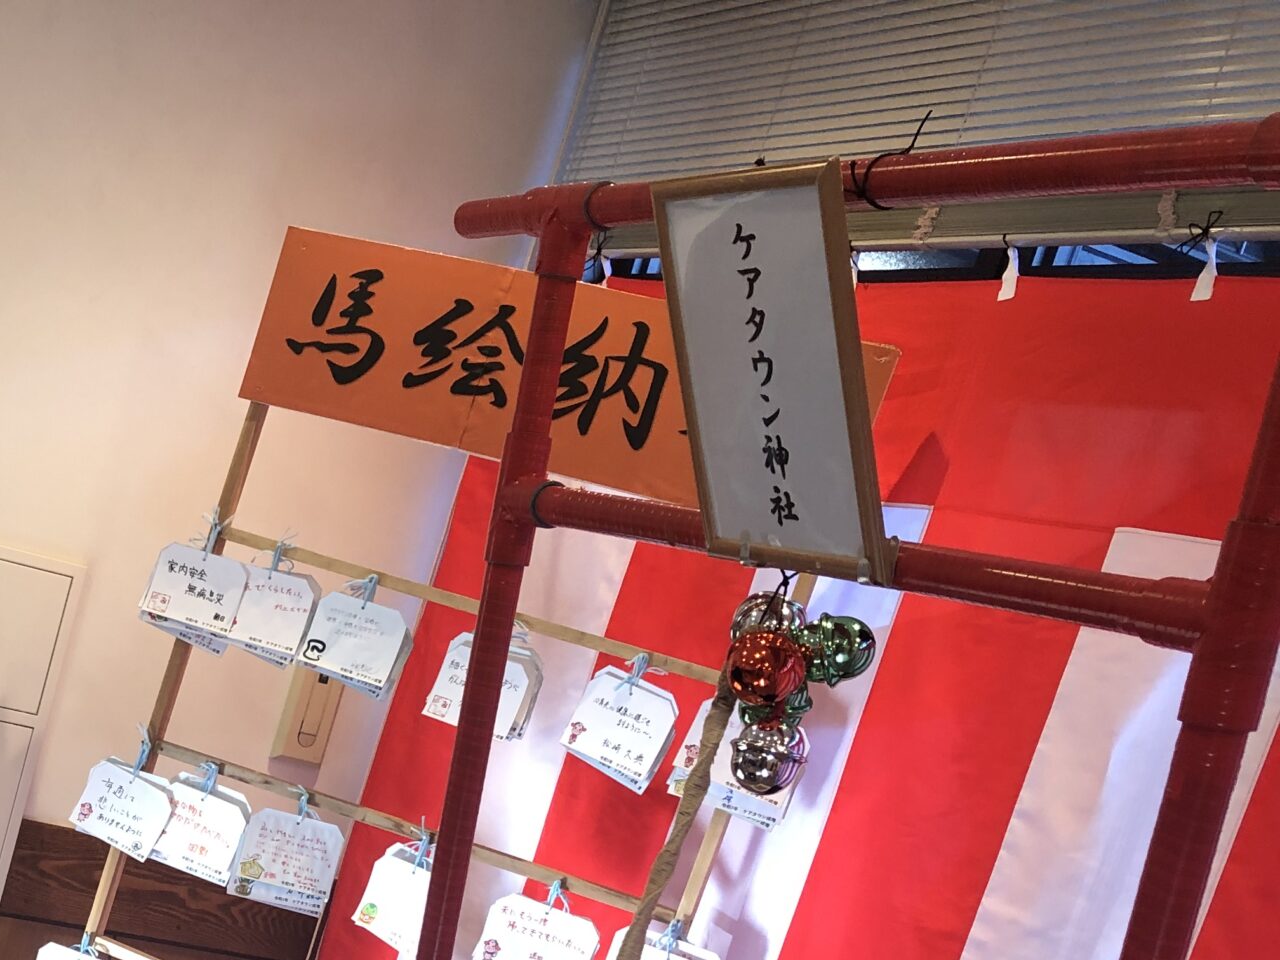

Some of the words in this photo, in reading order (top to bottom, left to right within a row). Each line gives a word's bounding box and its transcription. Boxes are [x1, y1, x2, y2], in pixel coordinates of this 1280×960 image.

[730, 222, 799, 526] ケアタウン神社
[166, 559, 209, 582] 家内安全
[184, 583, 226, 606] 無病息災
